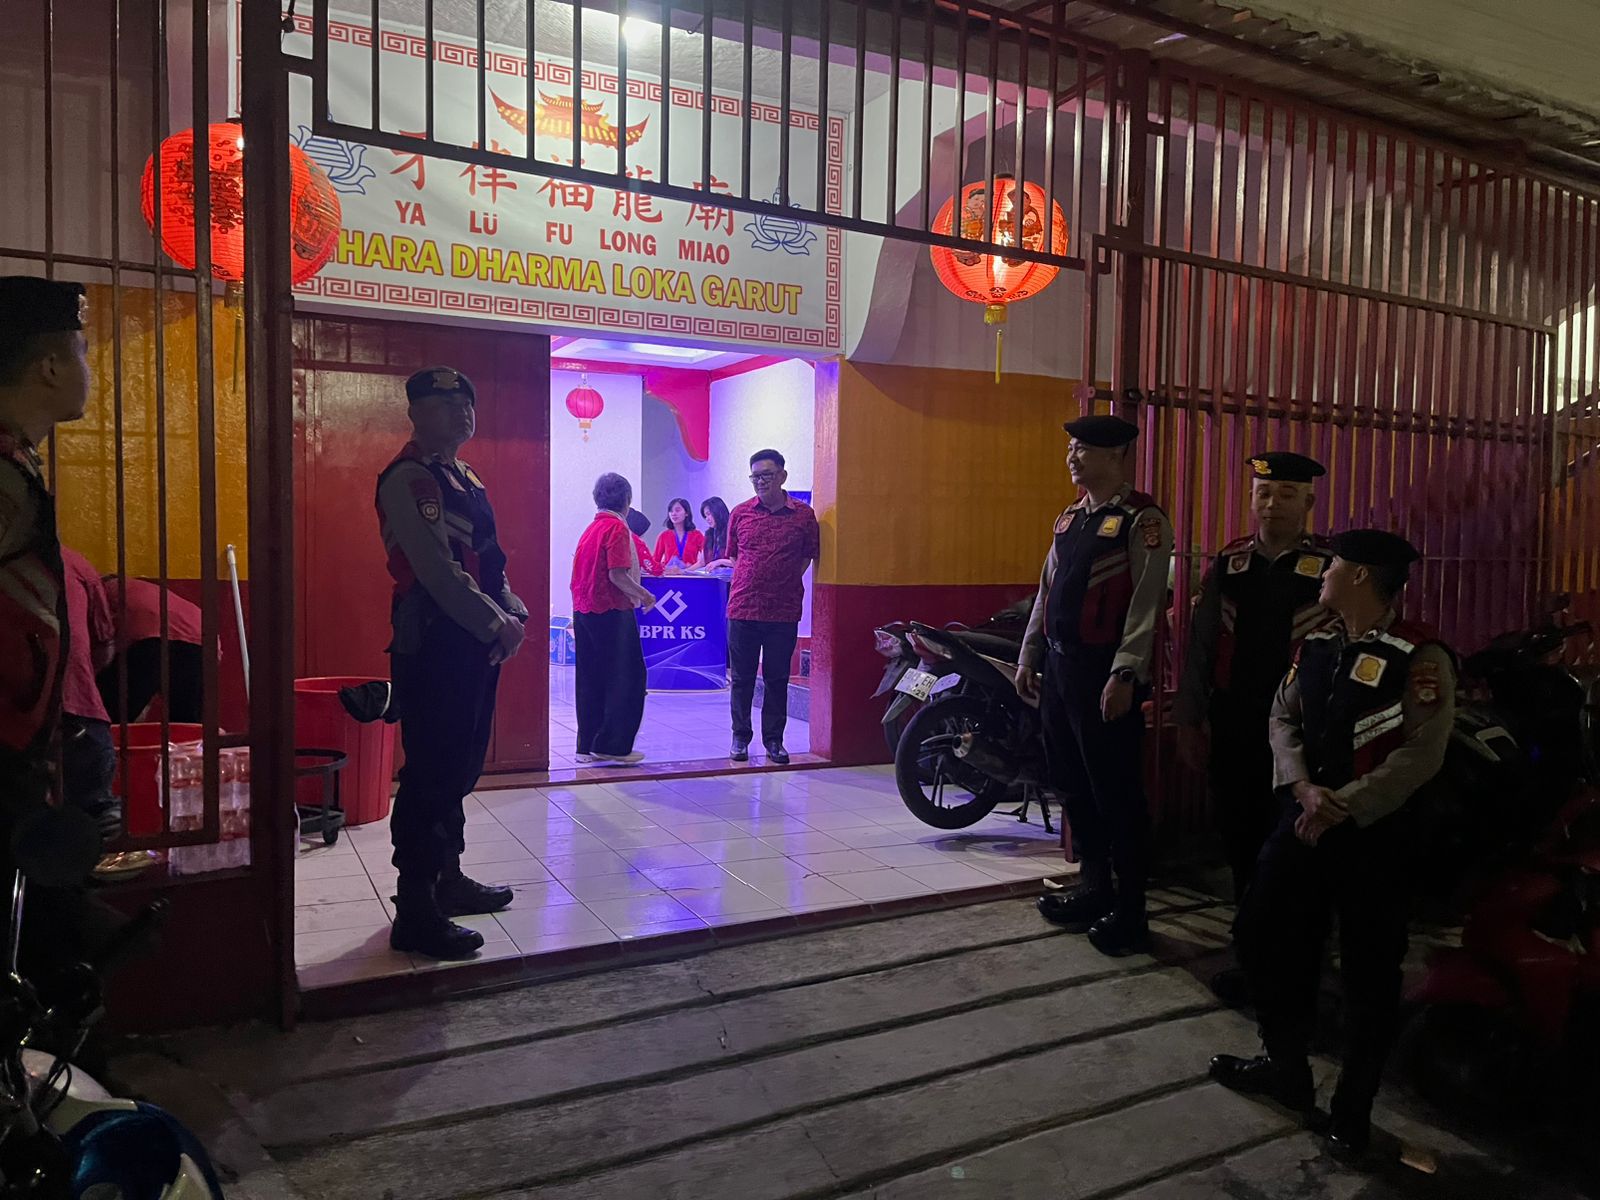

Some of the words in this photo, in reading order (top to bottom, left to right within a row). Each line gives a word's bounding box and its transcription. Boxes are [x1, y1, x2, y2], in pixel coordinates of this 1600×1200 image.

[395, 200, 426, 226] YA
[469, 210, 498, 236] LÜ
[545, 221, 573, 245] FU
[600, 228, 656, 256] LONG
[679, 239, 730, 265] MIAO
[330, 229, 444, 276] HARA
[450, 243, 606, 293] DHARMA
[613, 263, 696, 303] LOKA
[701, 274, 802, 315] GARUT
[640, 625, 676, 639] BPR
[680, 626, 706, 640] KS
